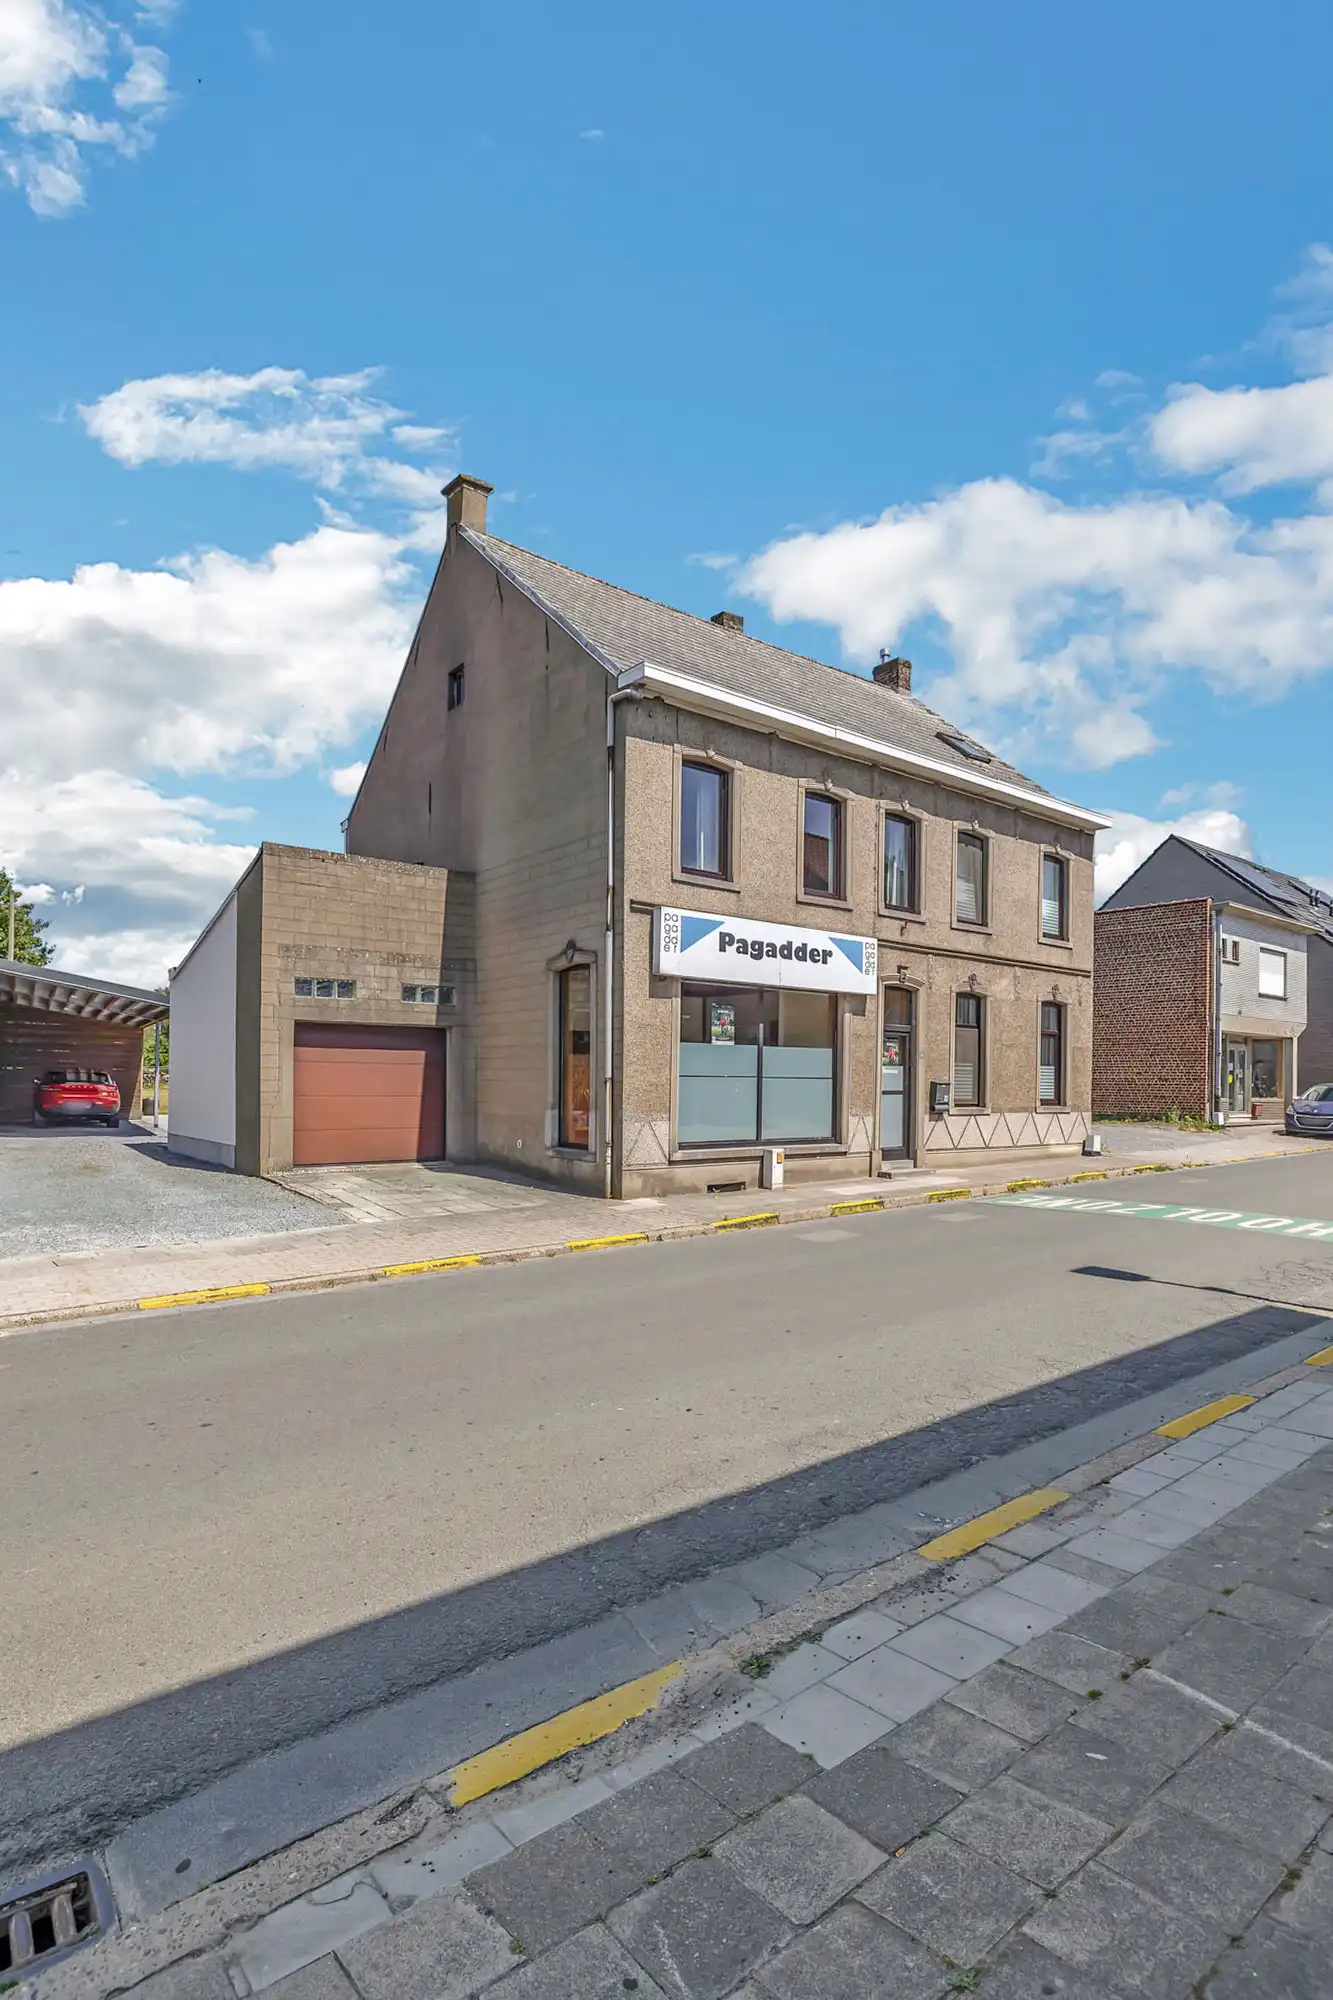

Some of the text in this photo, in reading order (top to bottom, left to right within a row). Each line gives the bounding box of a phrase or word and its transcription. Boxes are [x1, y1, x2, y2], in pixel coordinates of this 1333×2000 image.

[664, 913, 679, 923] pa
[664, 924, 679, 934] ga
[664, 935, 679, 945] dd
[718, 931, 833, 965] Pagadder
[865, 942, 876, 951] pa
